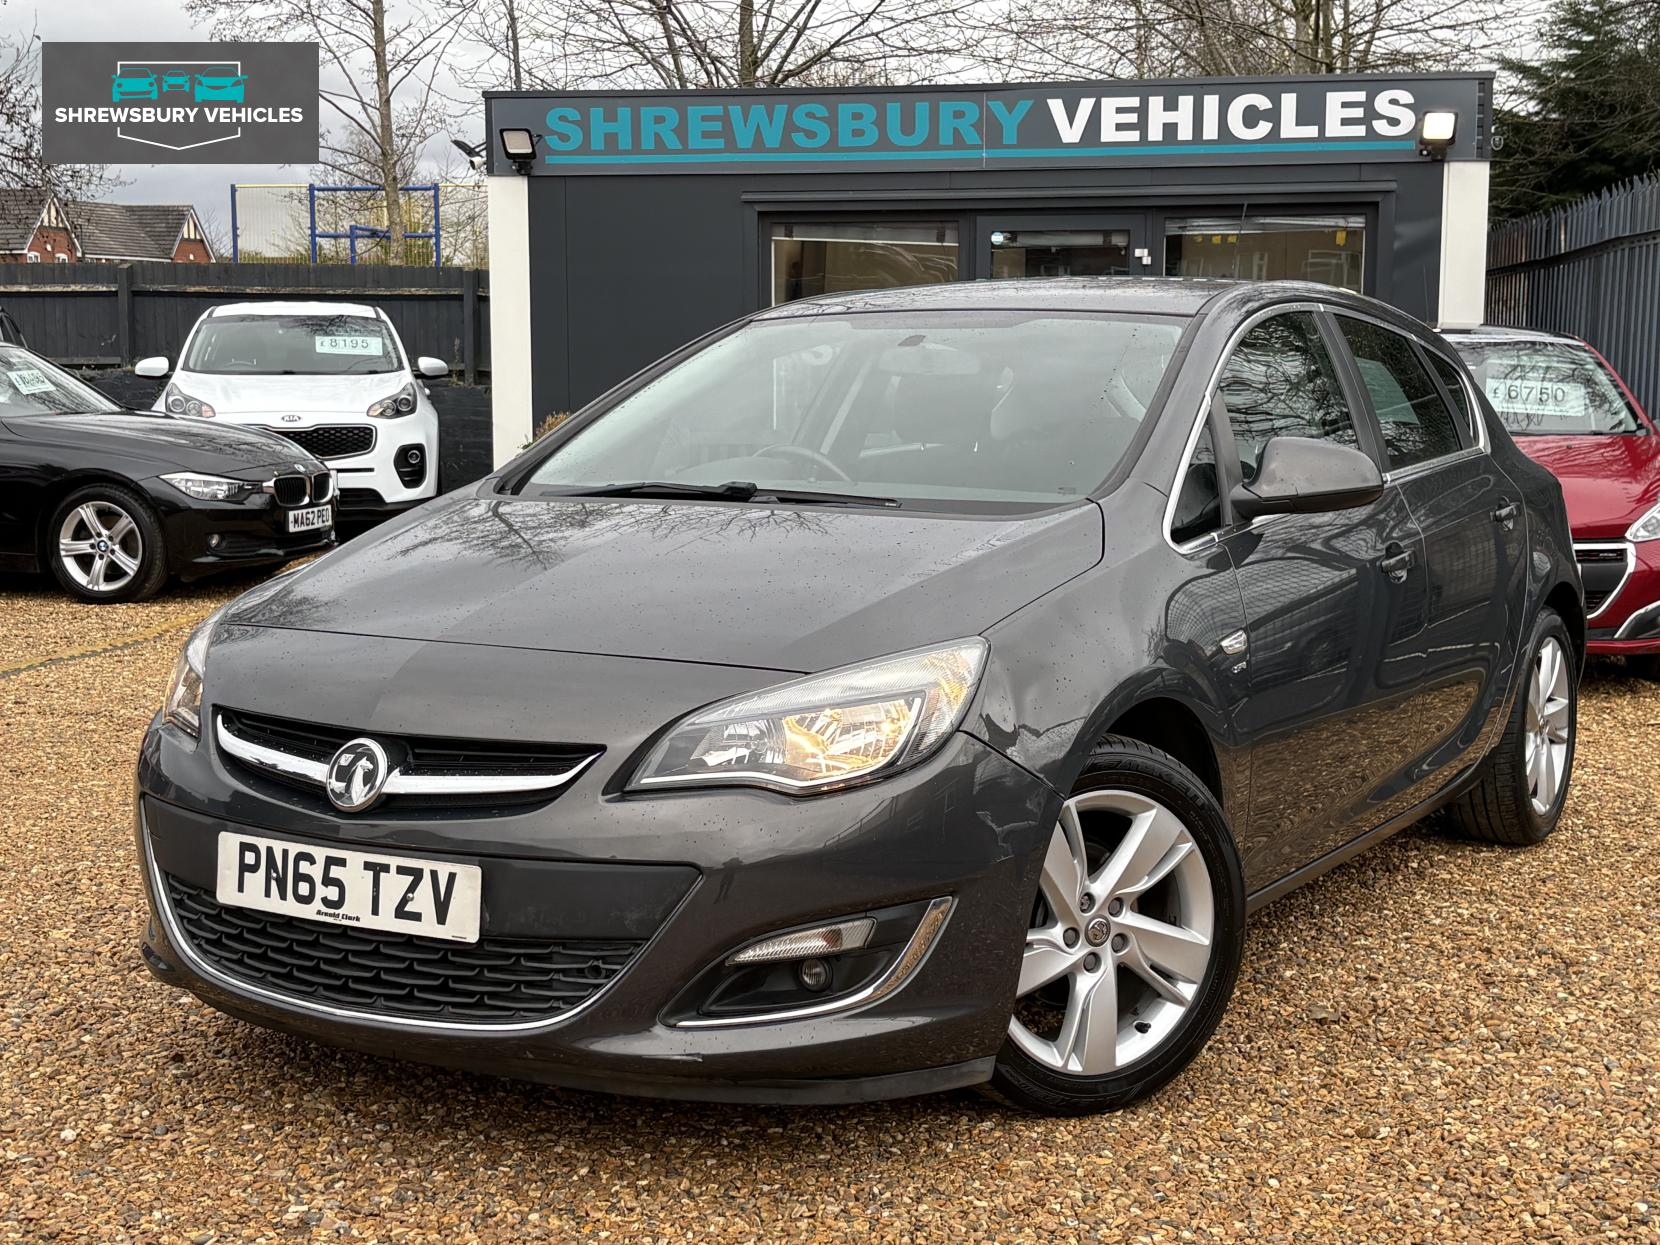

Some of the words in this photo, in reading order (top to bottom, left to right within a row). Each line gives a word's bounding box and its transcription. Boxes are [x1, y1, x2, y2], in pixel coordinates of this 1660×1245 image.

[545, 100, 1034, 151] SHREWSBURY
[1046, 89, 1416, 143] VEHICLES
[1493, 385, 1565, 402] £6750
[293, 511, 316, 528] MA62
[238, 841, 347, 910] PN65
[363, 861, 457, 925] TZV
[316, 910, 340, 918] Arnold
[341, 914, 361, 922] Clark
